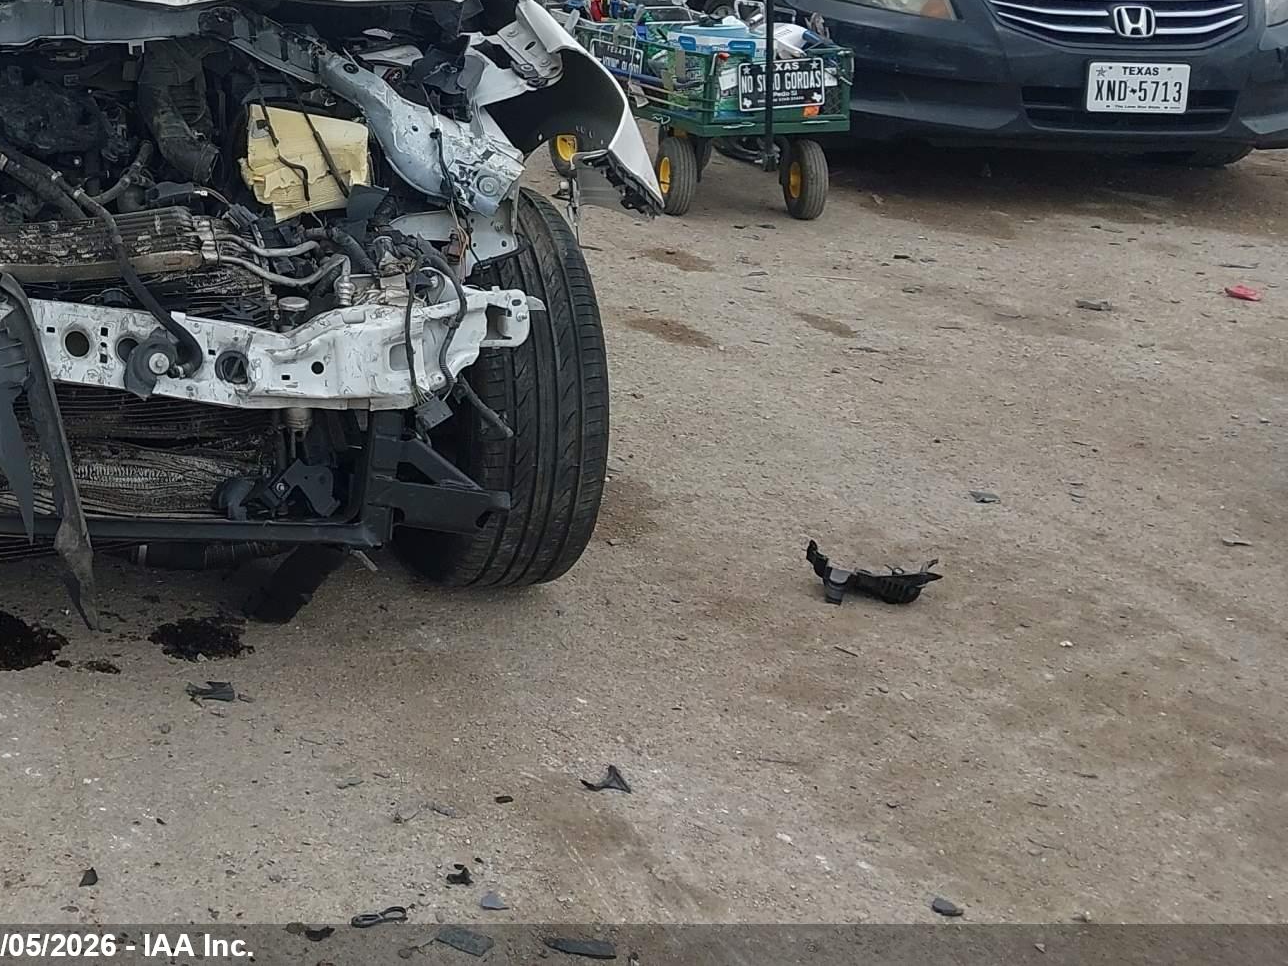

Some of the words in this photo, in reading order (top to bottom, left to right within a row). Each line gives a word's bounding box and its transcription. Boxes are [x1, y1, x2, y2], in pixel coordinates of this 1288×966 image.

[760, 62, 800, 74] TXAS
[1122, 66, 1160, 76] TEXAS
[741, 75, 754, 94] NO
[784, 70, 822, 90] GORDAS
[1095, 79, 1128, 102] XND
[1138, 80, 1183, 103] 5713
